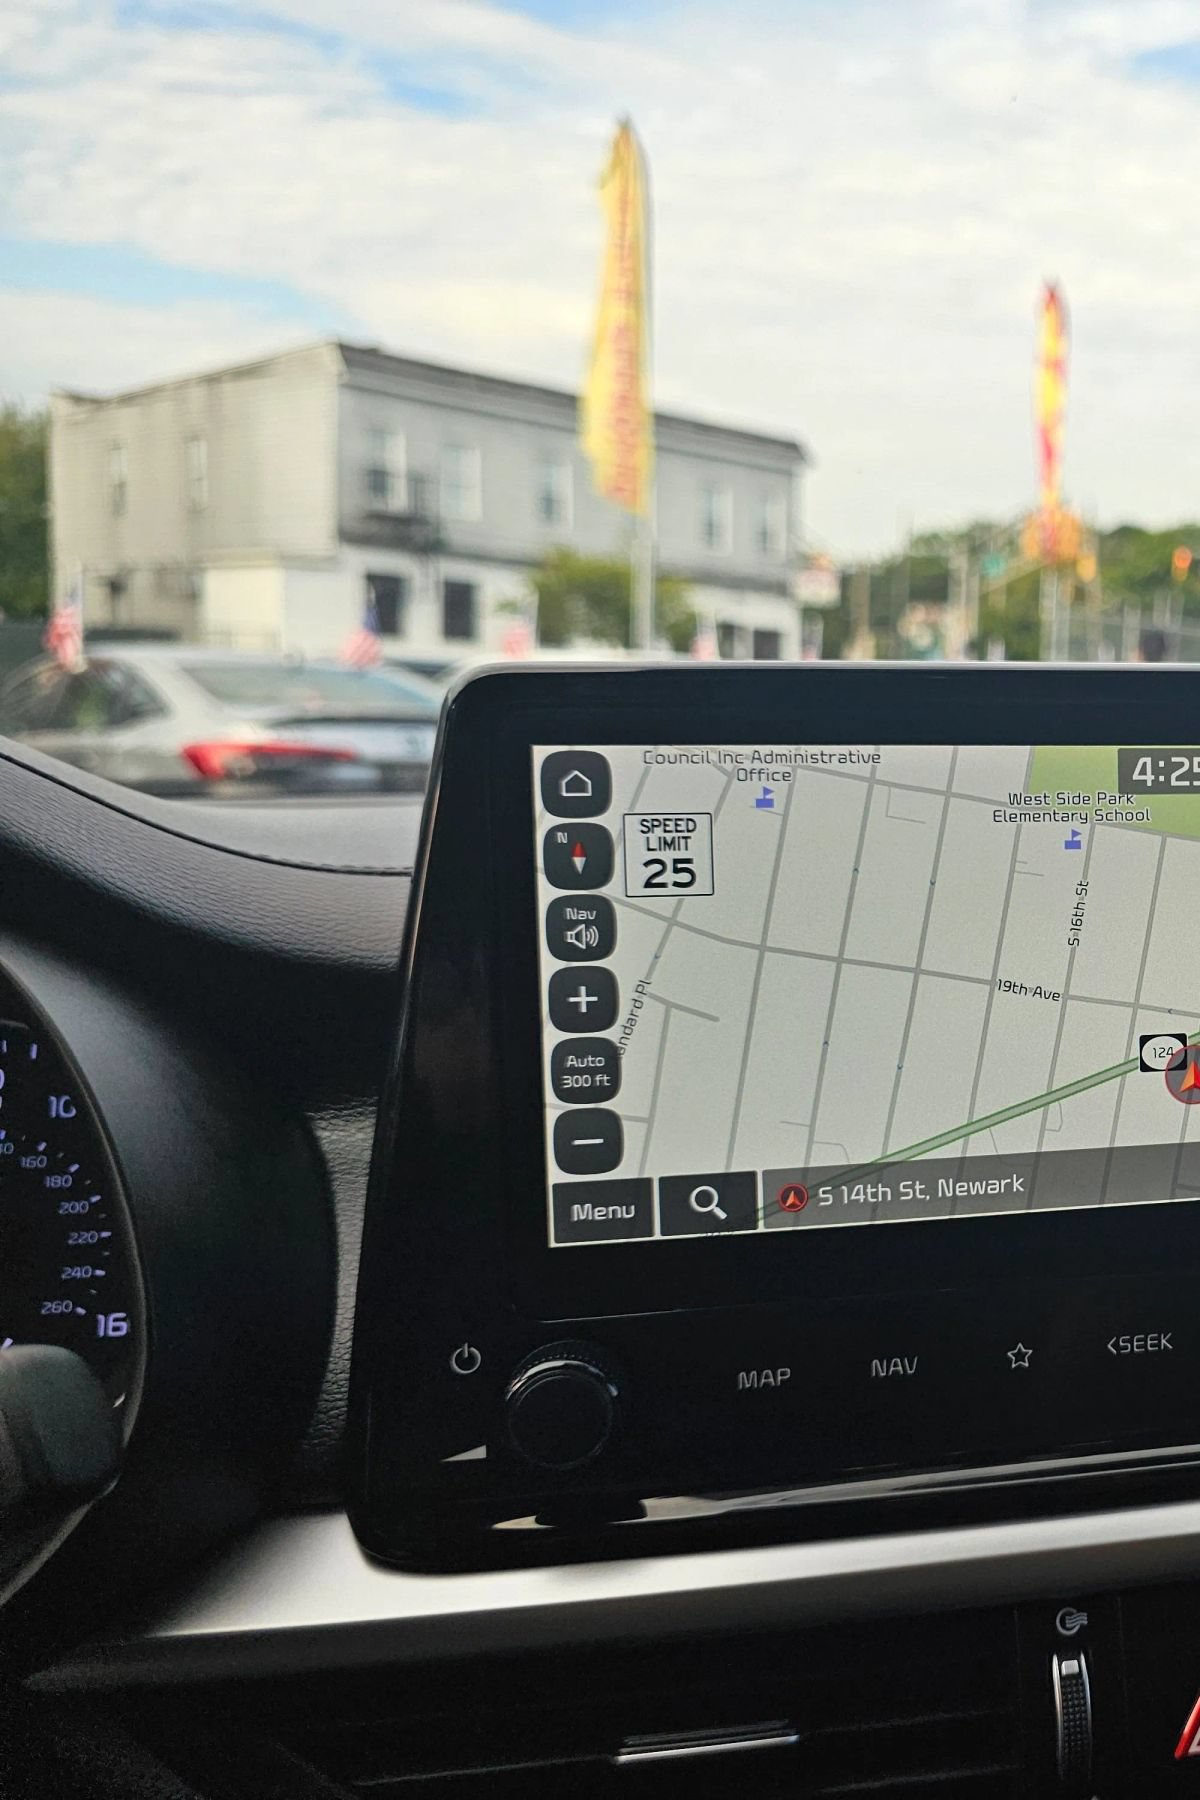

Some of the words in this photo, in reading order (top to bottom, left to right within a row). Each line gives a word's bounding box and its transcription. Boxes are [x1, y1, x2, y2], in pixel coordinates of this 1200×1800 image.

[643, 750, 712, 765] Council
[718, 750, 744, 764] Inc
[751, 750, 881, 764] Administrative
[736, 768, 791, 782] Office
[1008, 792, 1051, 806] West
[1056, 792, 1091, 805] Side
[1097, 792, 1135, 805] Park
[993, 809, 1088, 824] Elementary
[1094, 809, 1151, 822] School
[640, 818, 697, 834] SPEED
[557, 832, 568, 843] N
[646, 836, 692, 852] LIMIT
[642, 858, 697, 889] 25
[1076, 880, 1089, 897] St
[566, 908, 596, 920] Nav
[1070, 899, 1085, 933] 16th
[1068, 933, 1081, 947] S
[997, 979, 1027, 997] 19th
[1032, 986, 1061, 1002] Ave
[618, 999, 643, 1056] andard
[635, 979, 652, 996] Pl
[1152, 1047, 1174, 1059] 124
[567, 1055, 605, 1067] Auto
[562, 1075, 591, 1088] 300
[595, 1074, 611, 1086] ft
[45, 1175, 72, 1188] 180
[818, 1188, 833, 1206] S
[840, 1183, 892, 1204] 14th
[899, 1180, 930, 1200] St,
[938, 1174, 1025, 1197] Newark
[58, 1201, 89, 1214] 200
[571, 1203, 635, 1221] Menu
[68, 1231, 98, 1244] 220
[61, 1265, 92, 1279] 240
[41, 1300, 73, 1315] 260
[871, 1357, 918, 1378] NAV
[737, 1368, 791, 1390] MAP
